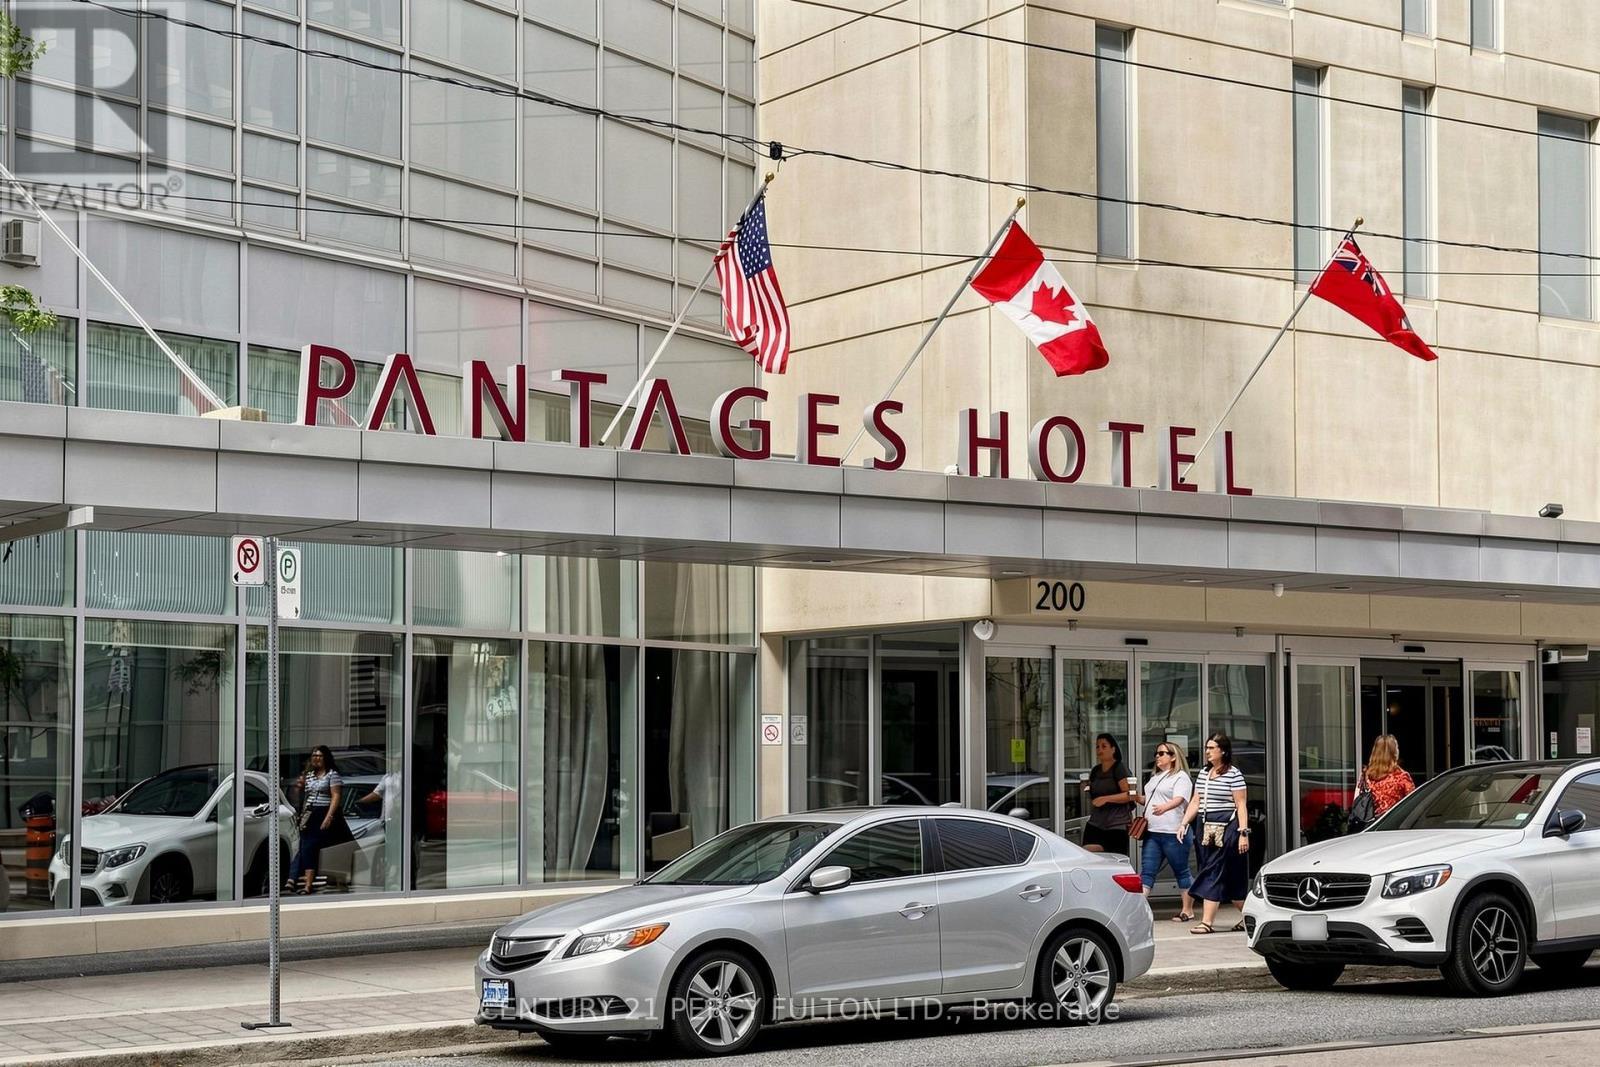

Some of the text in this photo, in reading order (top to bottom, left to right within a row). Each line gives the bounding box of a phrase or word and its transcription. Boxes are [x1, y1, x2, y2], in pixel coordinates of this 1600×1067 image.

[299, 344, 1253, 496] PANTAGES HOTEL
[1035, 581, 1085, 611] 200
